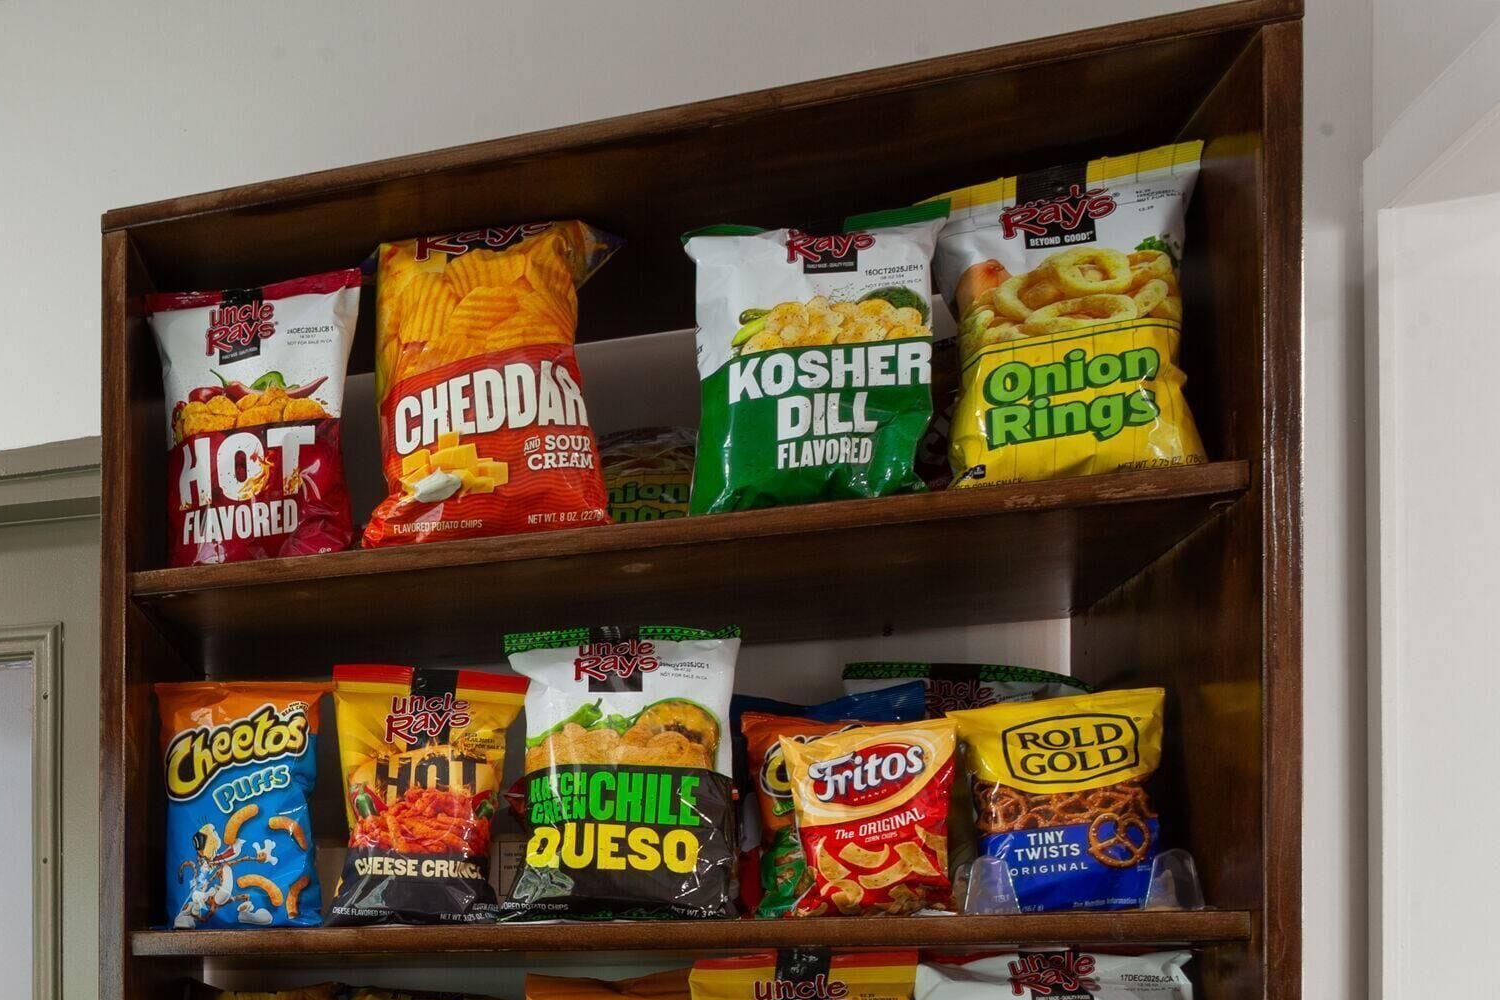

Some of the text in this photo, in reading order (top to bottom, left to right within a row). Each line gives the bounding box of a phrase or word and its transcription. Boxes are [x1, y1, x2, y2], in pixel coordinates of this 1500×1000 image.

[1029, 236, 1061, 247] BEYOND
[209, 302, 275, 328] uncle
[728, 341, 932, 404] KOSHER
[983, 347, 1160, 406] Onion
[394, 360, 589, 455] CHEDDAR
[777, 392, 878, 441] DILL
[987, 389, 1160, 451] Rings
[523, 435, 591, 452] AND SOUR
[777, 438, 873, 470] FLAVORED
[180, 425, 316, 510] HOT
[528, 453, 594, 471] CREAM
[183, 500, 299, 545] FLAVORED
[394, 519, 483, 534] FLAVORED POTATO CHIPS
[527, 511, 579, 524] NET WT. OZ.
[579, 639, 656, 657] uncle
[392, 693, 470, 714] uncle
[1016, 723, 1124, 751] ROLD
[167, 706, 307, 797] Cheetos
[1020, 746, 1129, 776] GOLD
[375, 755, 488, 803] HOT
[808, 745, 924, 802] Fritos
[530, 771, 700, 826] HATCH CHILE
[853, 788, 888, 801] BRAND
[530, 796, 586, 825] GREEN
[835, 807, 927, 840] The ORIGINAL
[526, 822, 699, 873] QUESO
[864, 831, 898, 843] CORN CHIPS
[1027, 830, 1065, 846] TINY
[1014, 843, 1081, 861] TWISTS
[354, 857, 418, 877] CHEESE
[1010, 861, 1088, 877] ORIGINAL
[754, 974, 847, 1000] uncle
